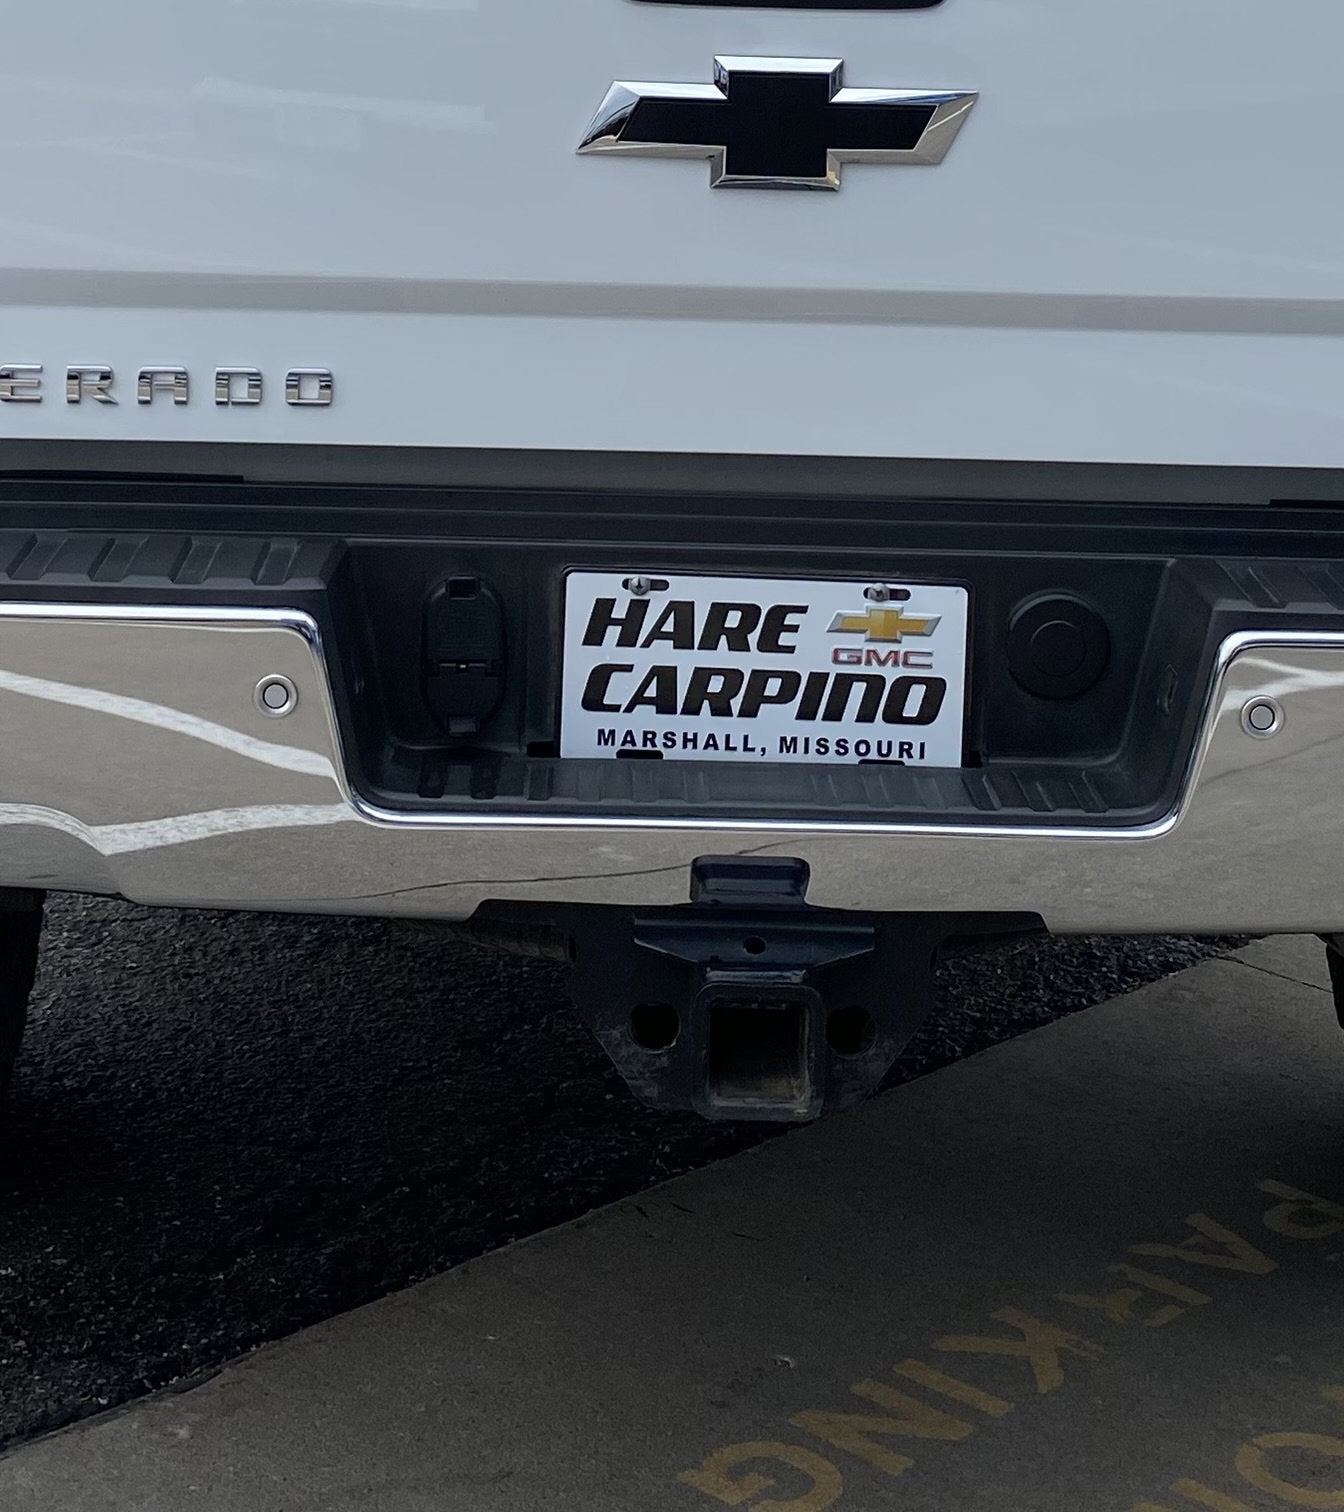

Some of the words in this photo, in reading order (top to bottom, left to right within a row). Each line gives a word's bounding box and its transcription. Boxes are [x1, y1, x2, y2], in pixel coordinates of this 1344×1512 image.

[581, 597, 809, 654] HARE
[831, 647, 934, 670] GMC
[580, 663, 947, 726] CARPINO
[596, 728, 767, 757] MARSHALL,
[778, 735, 927, 760] MISSOURI
